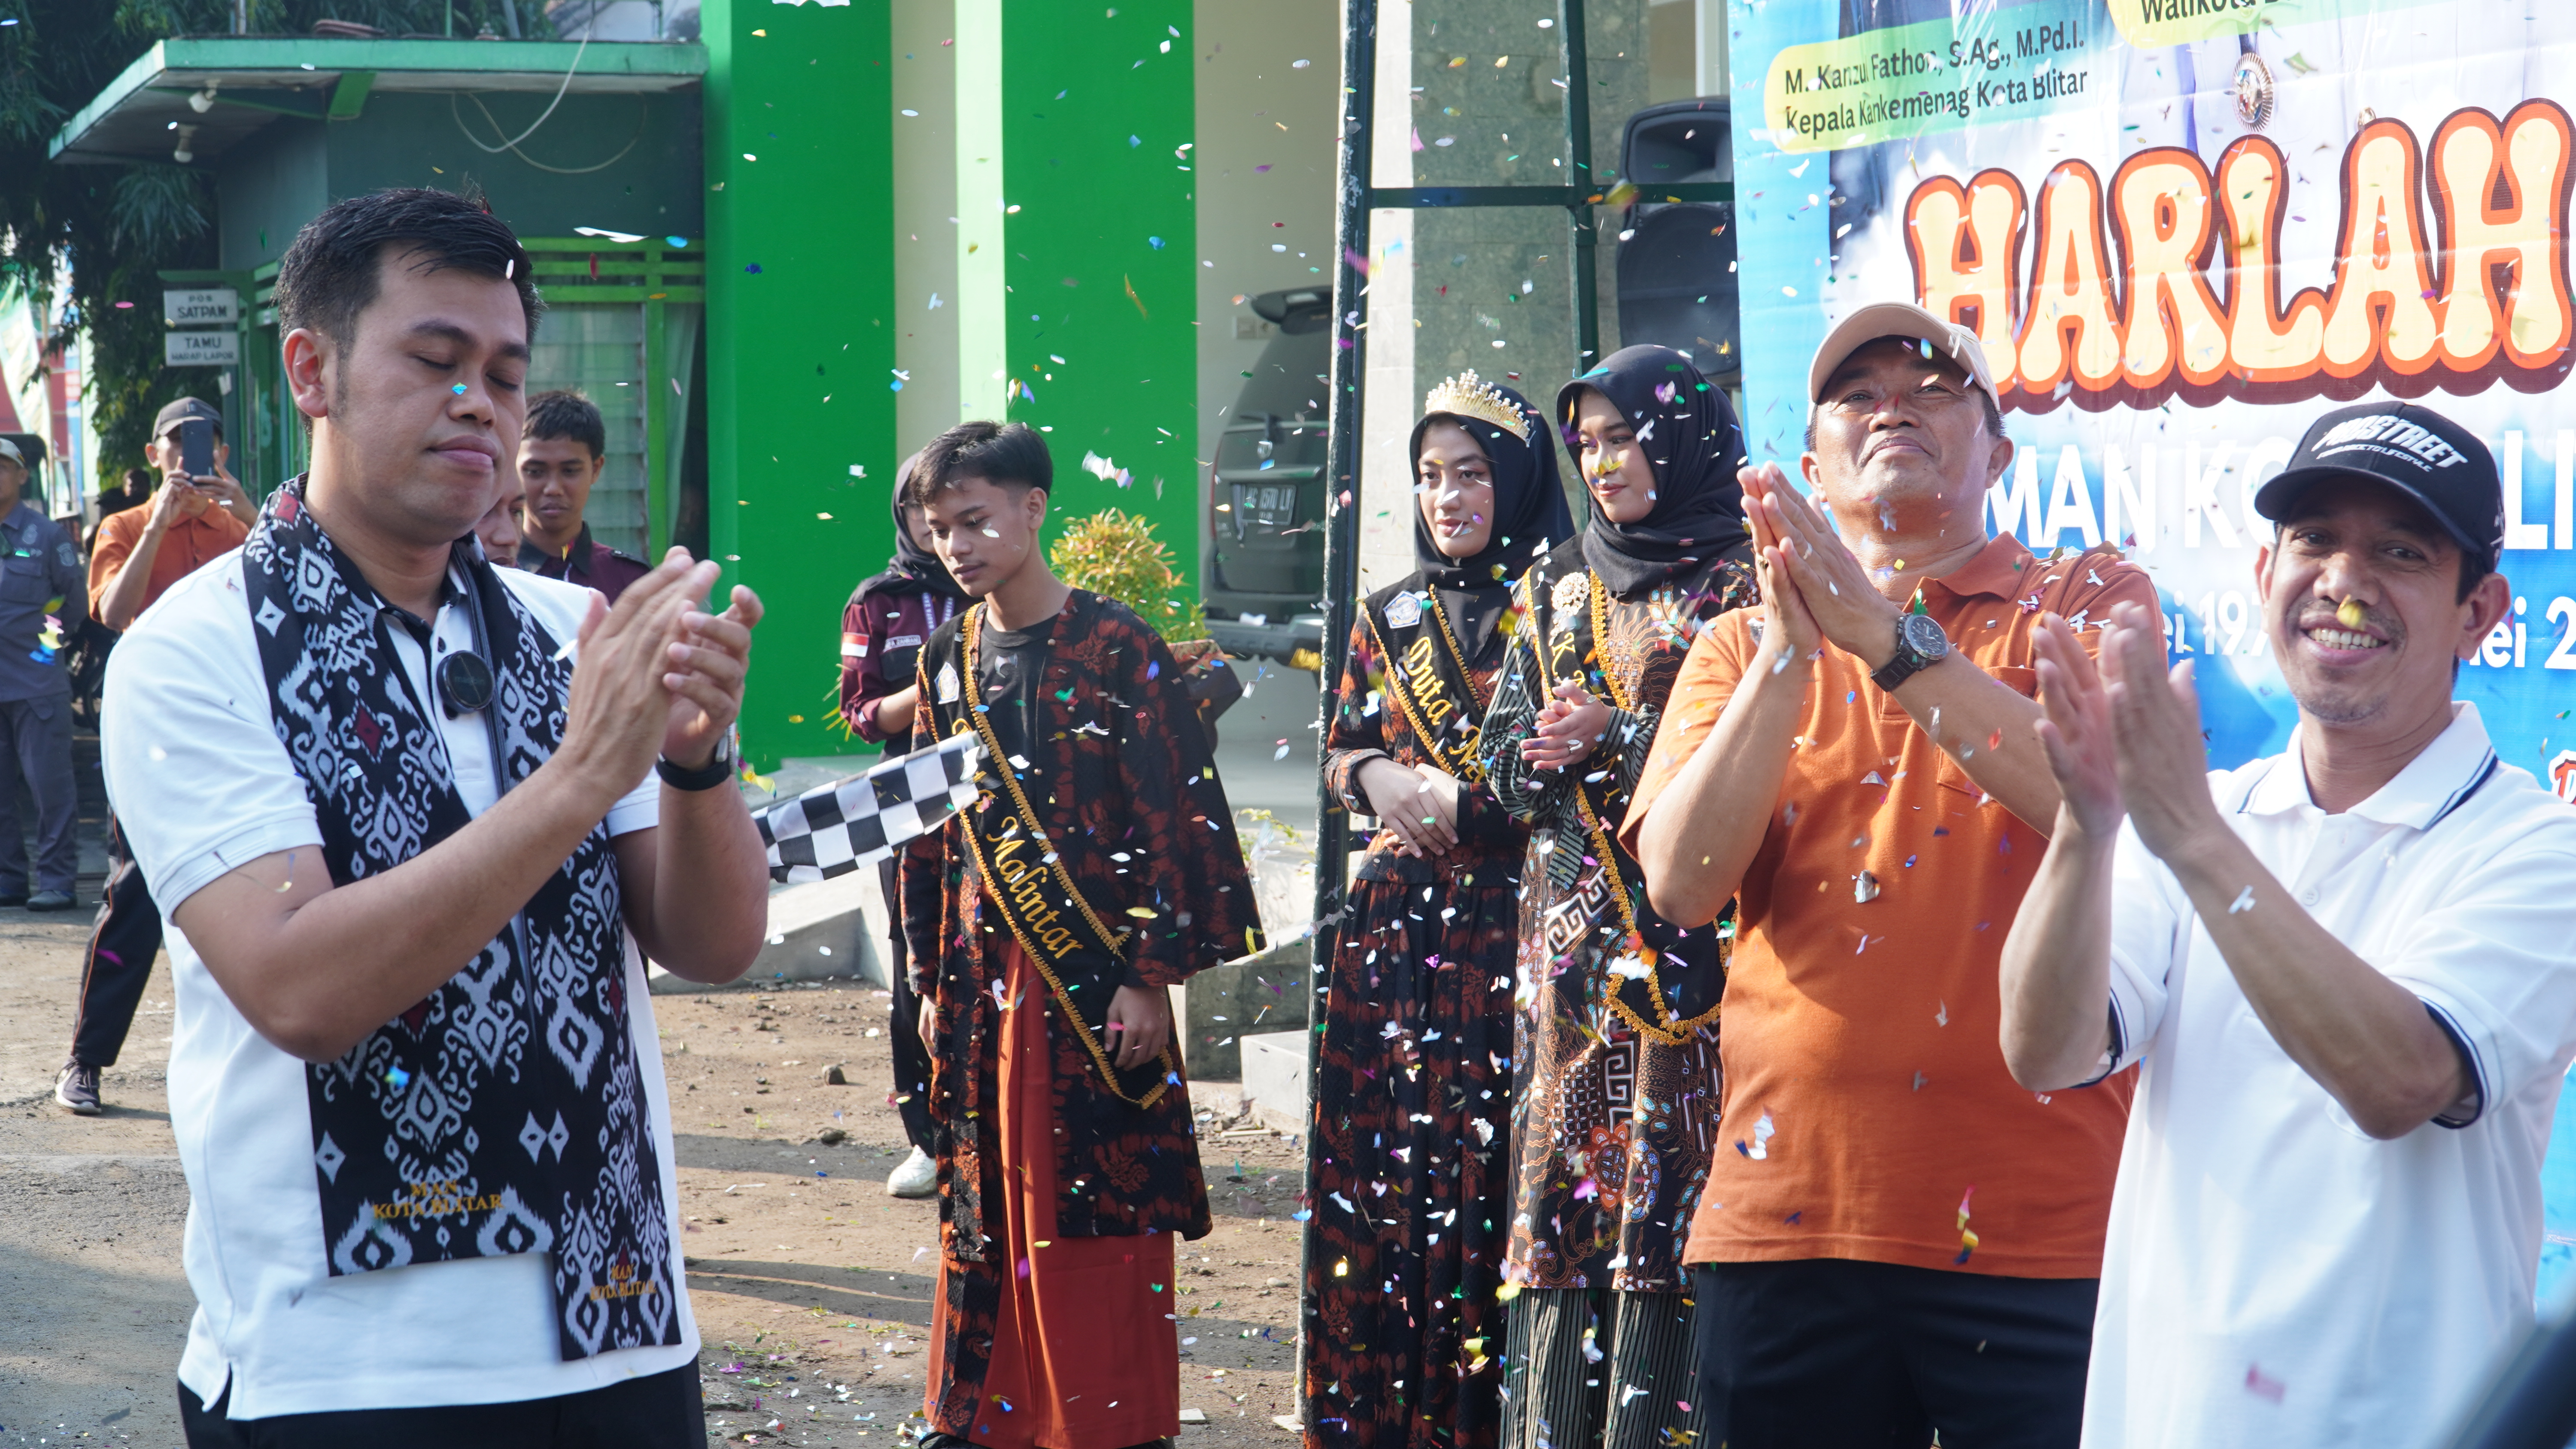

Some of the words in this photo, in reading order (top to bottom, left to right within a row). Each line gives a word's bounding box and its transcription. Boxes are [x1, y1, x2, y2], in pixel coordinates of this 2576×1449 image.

[1786, 68, 1809, 95] M.
[2017, 20, 2084, 59] M.Pd.I.
[1786, 103, 1855, 140] Kepala
[1859, 87, 1970, 126] Kankemenag
[2033, 68, 2087, 101] Blitar
[1903, 98, 2576, 415] HARLAH
[177, 305, 227, 318] SATPAM
[185, 336, 222, 349] TAMU
[1984, 443, 2157, 549] MAN
[2184, 436, 2295, 549] KO
[2469, 596, 2527, 668] ei
[1404, 636, 1453, 726] Duta
[986, 816, 1084, 959] Malintar
[373, 1203, 424, 1219] KOTA
[431, 1194, 505, 1214] BLITAR
[410, 1179, 457, 1197] MAN
[611, 1264, 634, 1280] MAN
